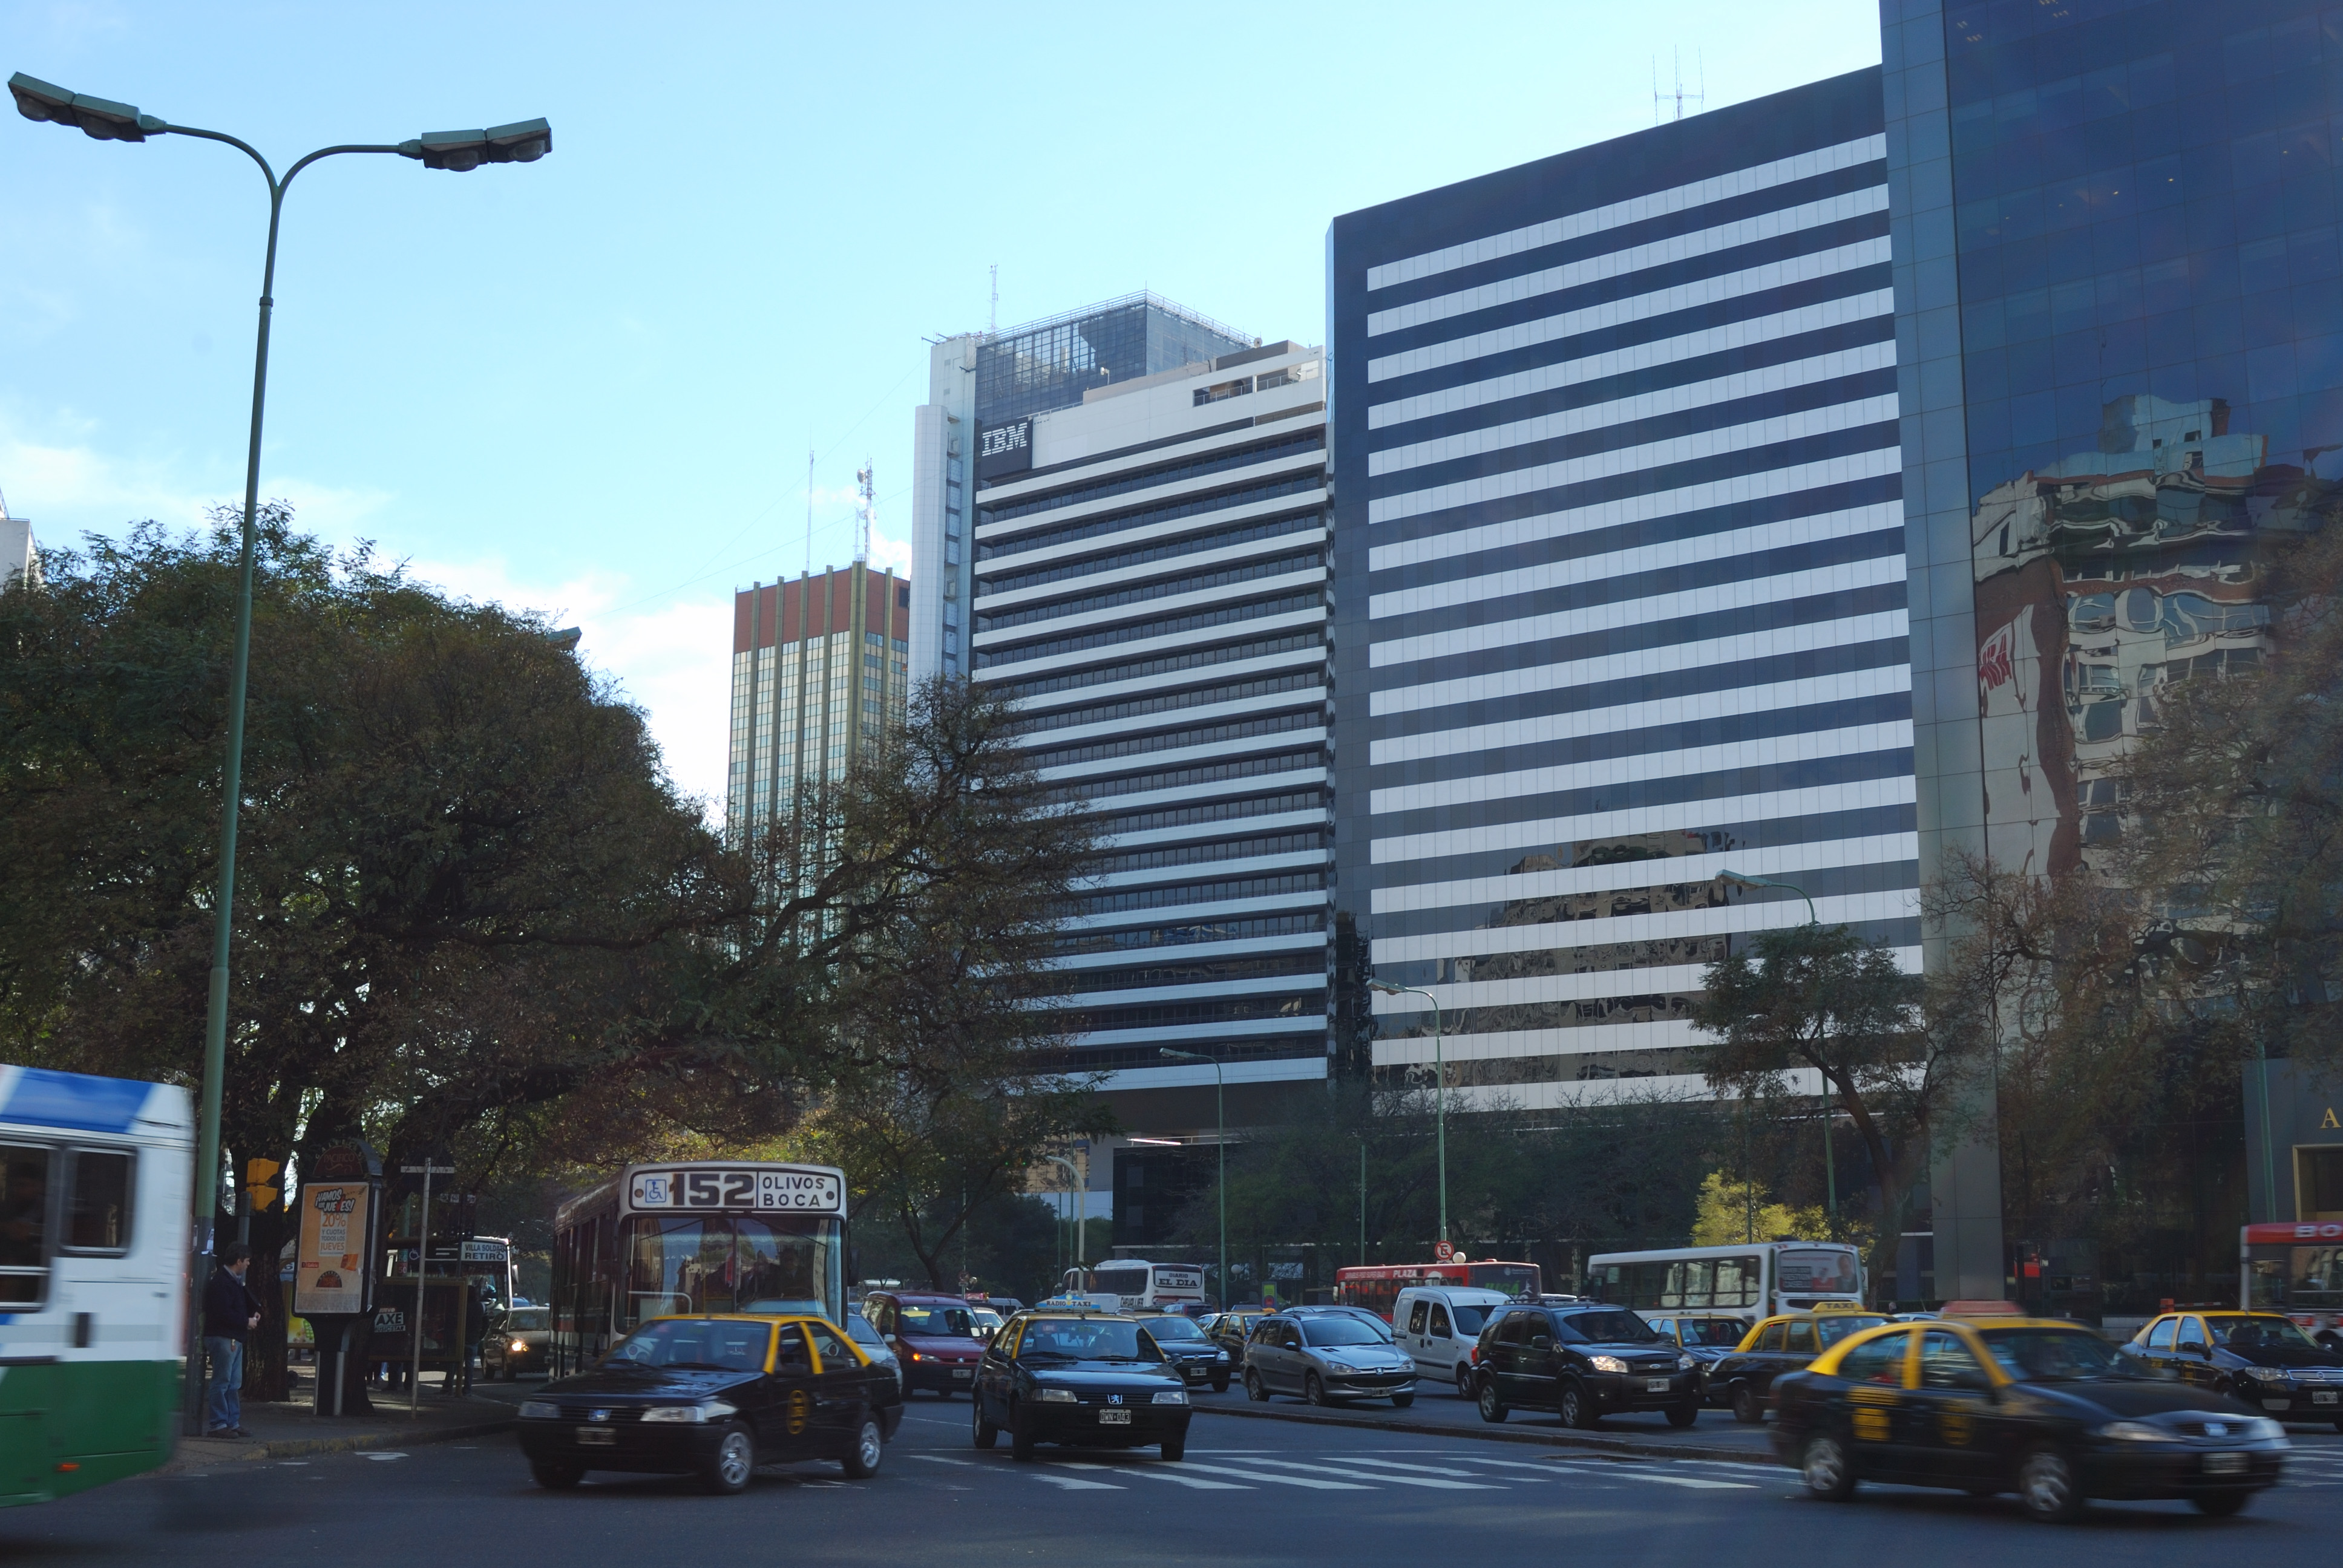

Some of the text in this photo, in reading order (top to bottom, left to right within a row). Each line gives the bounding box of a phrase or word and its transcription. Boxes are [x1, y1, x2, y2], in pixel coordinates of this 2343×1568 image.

[982, 422, 1027, 457] IBM
[2319, 1106, 2342, 1128] A
[762, 1177, 825, 1189] OLIVOS
[670, 1174, 754, 1206] 152
[764, 1194, 820, 1207] BOCA
[323, 1213, 346, 1227] 20%
[1393, 1269, 1417, 1278] PLAZA
[376, 1313, 402, 1325] AXE
[1117, 1413, 1130, 1421] 043
